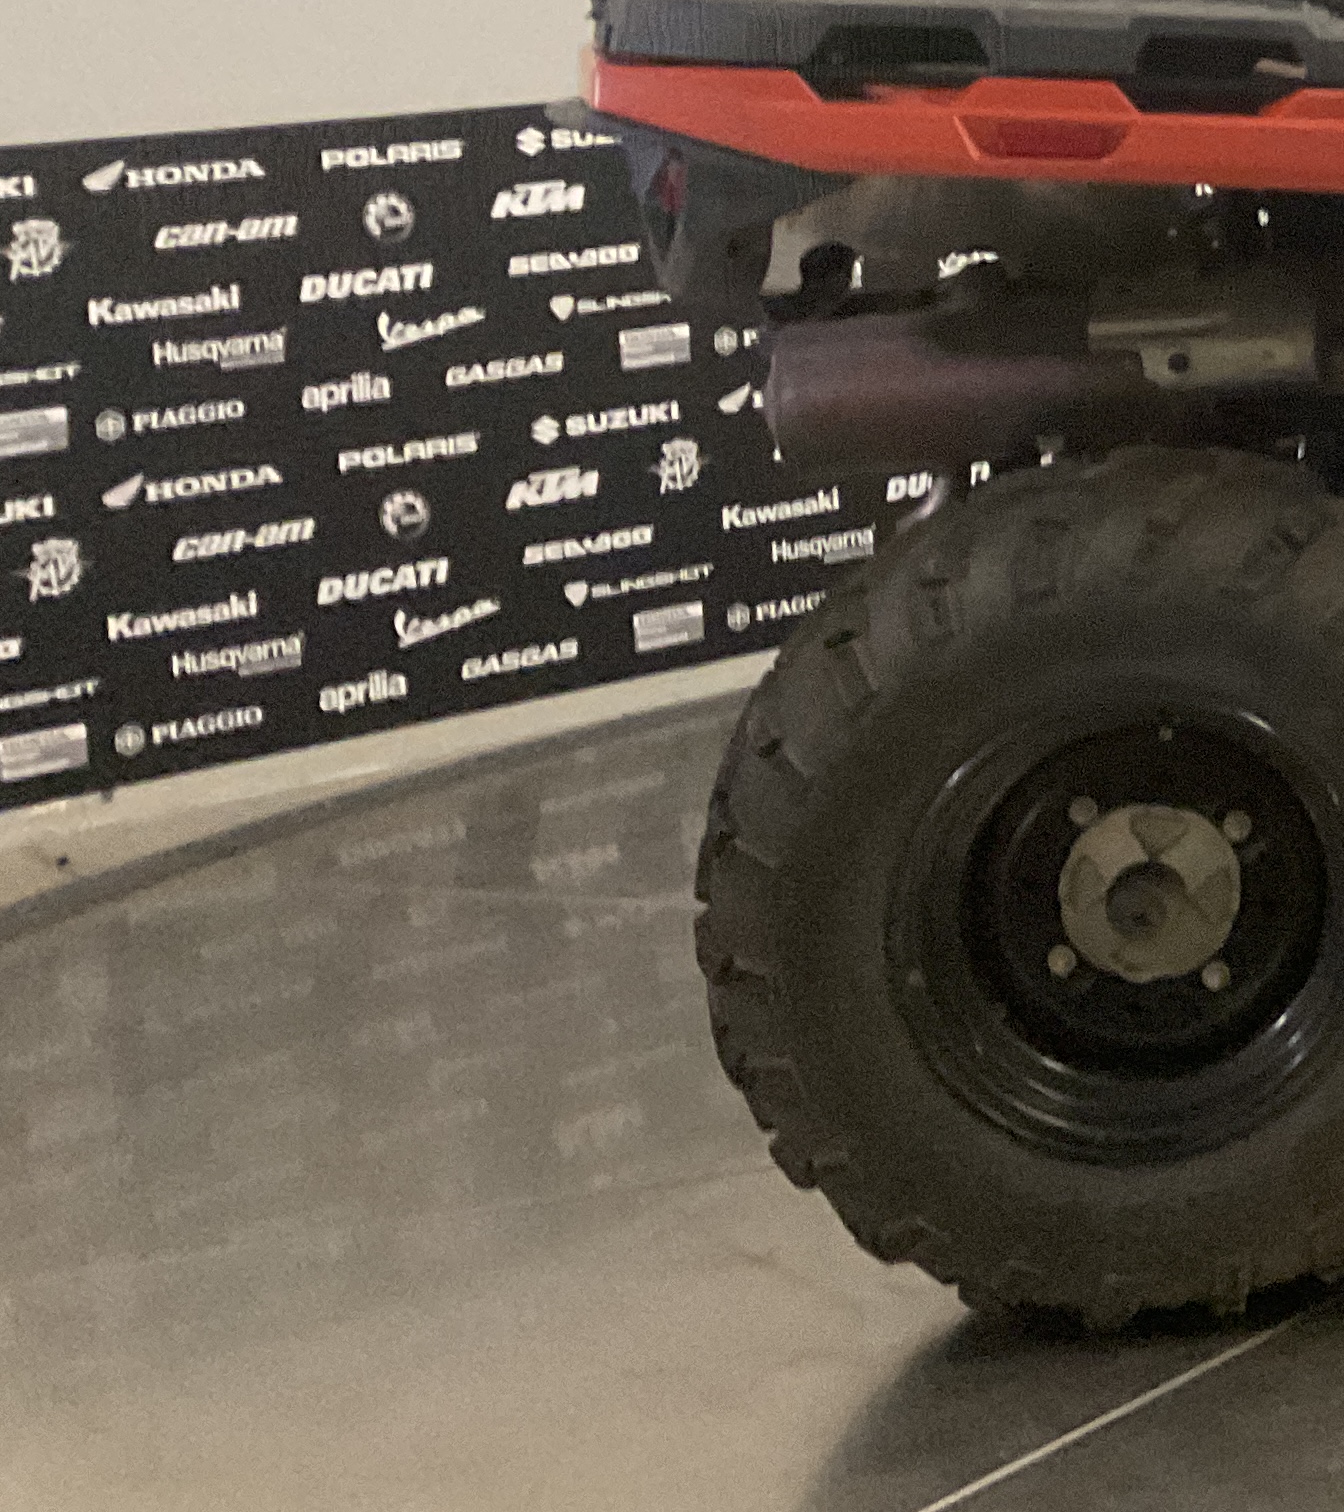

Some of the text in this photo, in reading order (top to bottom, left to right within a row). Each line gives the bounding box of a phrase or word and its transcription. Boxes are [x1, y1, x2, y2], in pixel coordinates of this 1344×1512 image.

[125, 158, 266, 189] HONDA
[320, 139, 463, 171] POLARIS
[490, 179, 586, 219] KTM
[299, 262, 434, 303] DUCATI
[87, 283, 240, 327] Kawasaki
[445, 352, 564, 388] GASGAS
[301, 371, 391, 413] aprilia
[565, 400, 680, 437] SUZUKI
[338, 431, 480, 473] POLARIS
[144, 464, 283, 503] HONDA
[505, 466, 600, 510] KTM
[721, 486, 840, 531] Kawasaki
[317, 557, 449, 606] DUCATI
[107, 589, 258, 642] Kawasaki
[461, 638, 579, 681] GASGAS
[319, 669, 408, 714] aprilia
